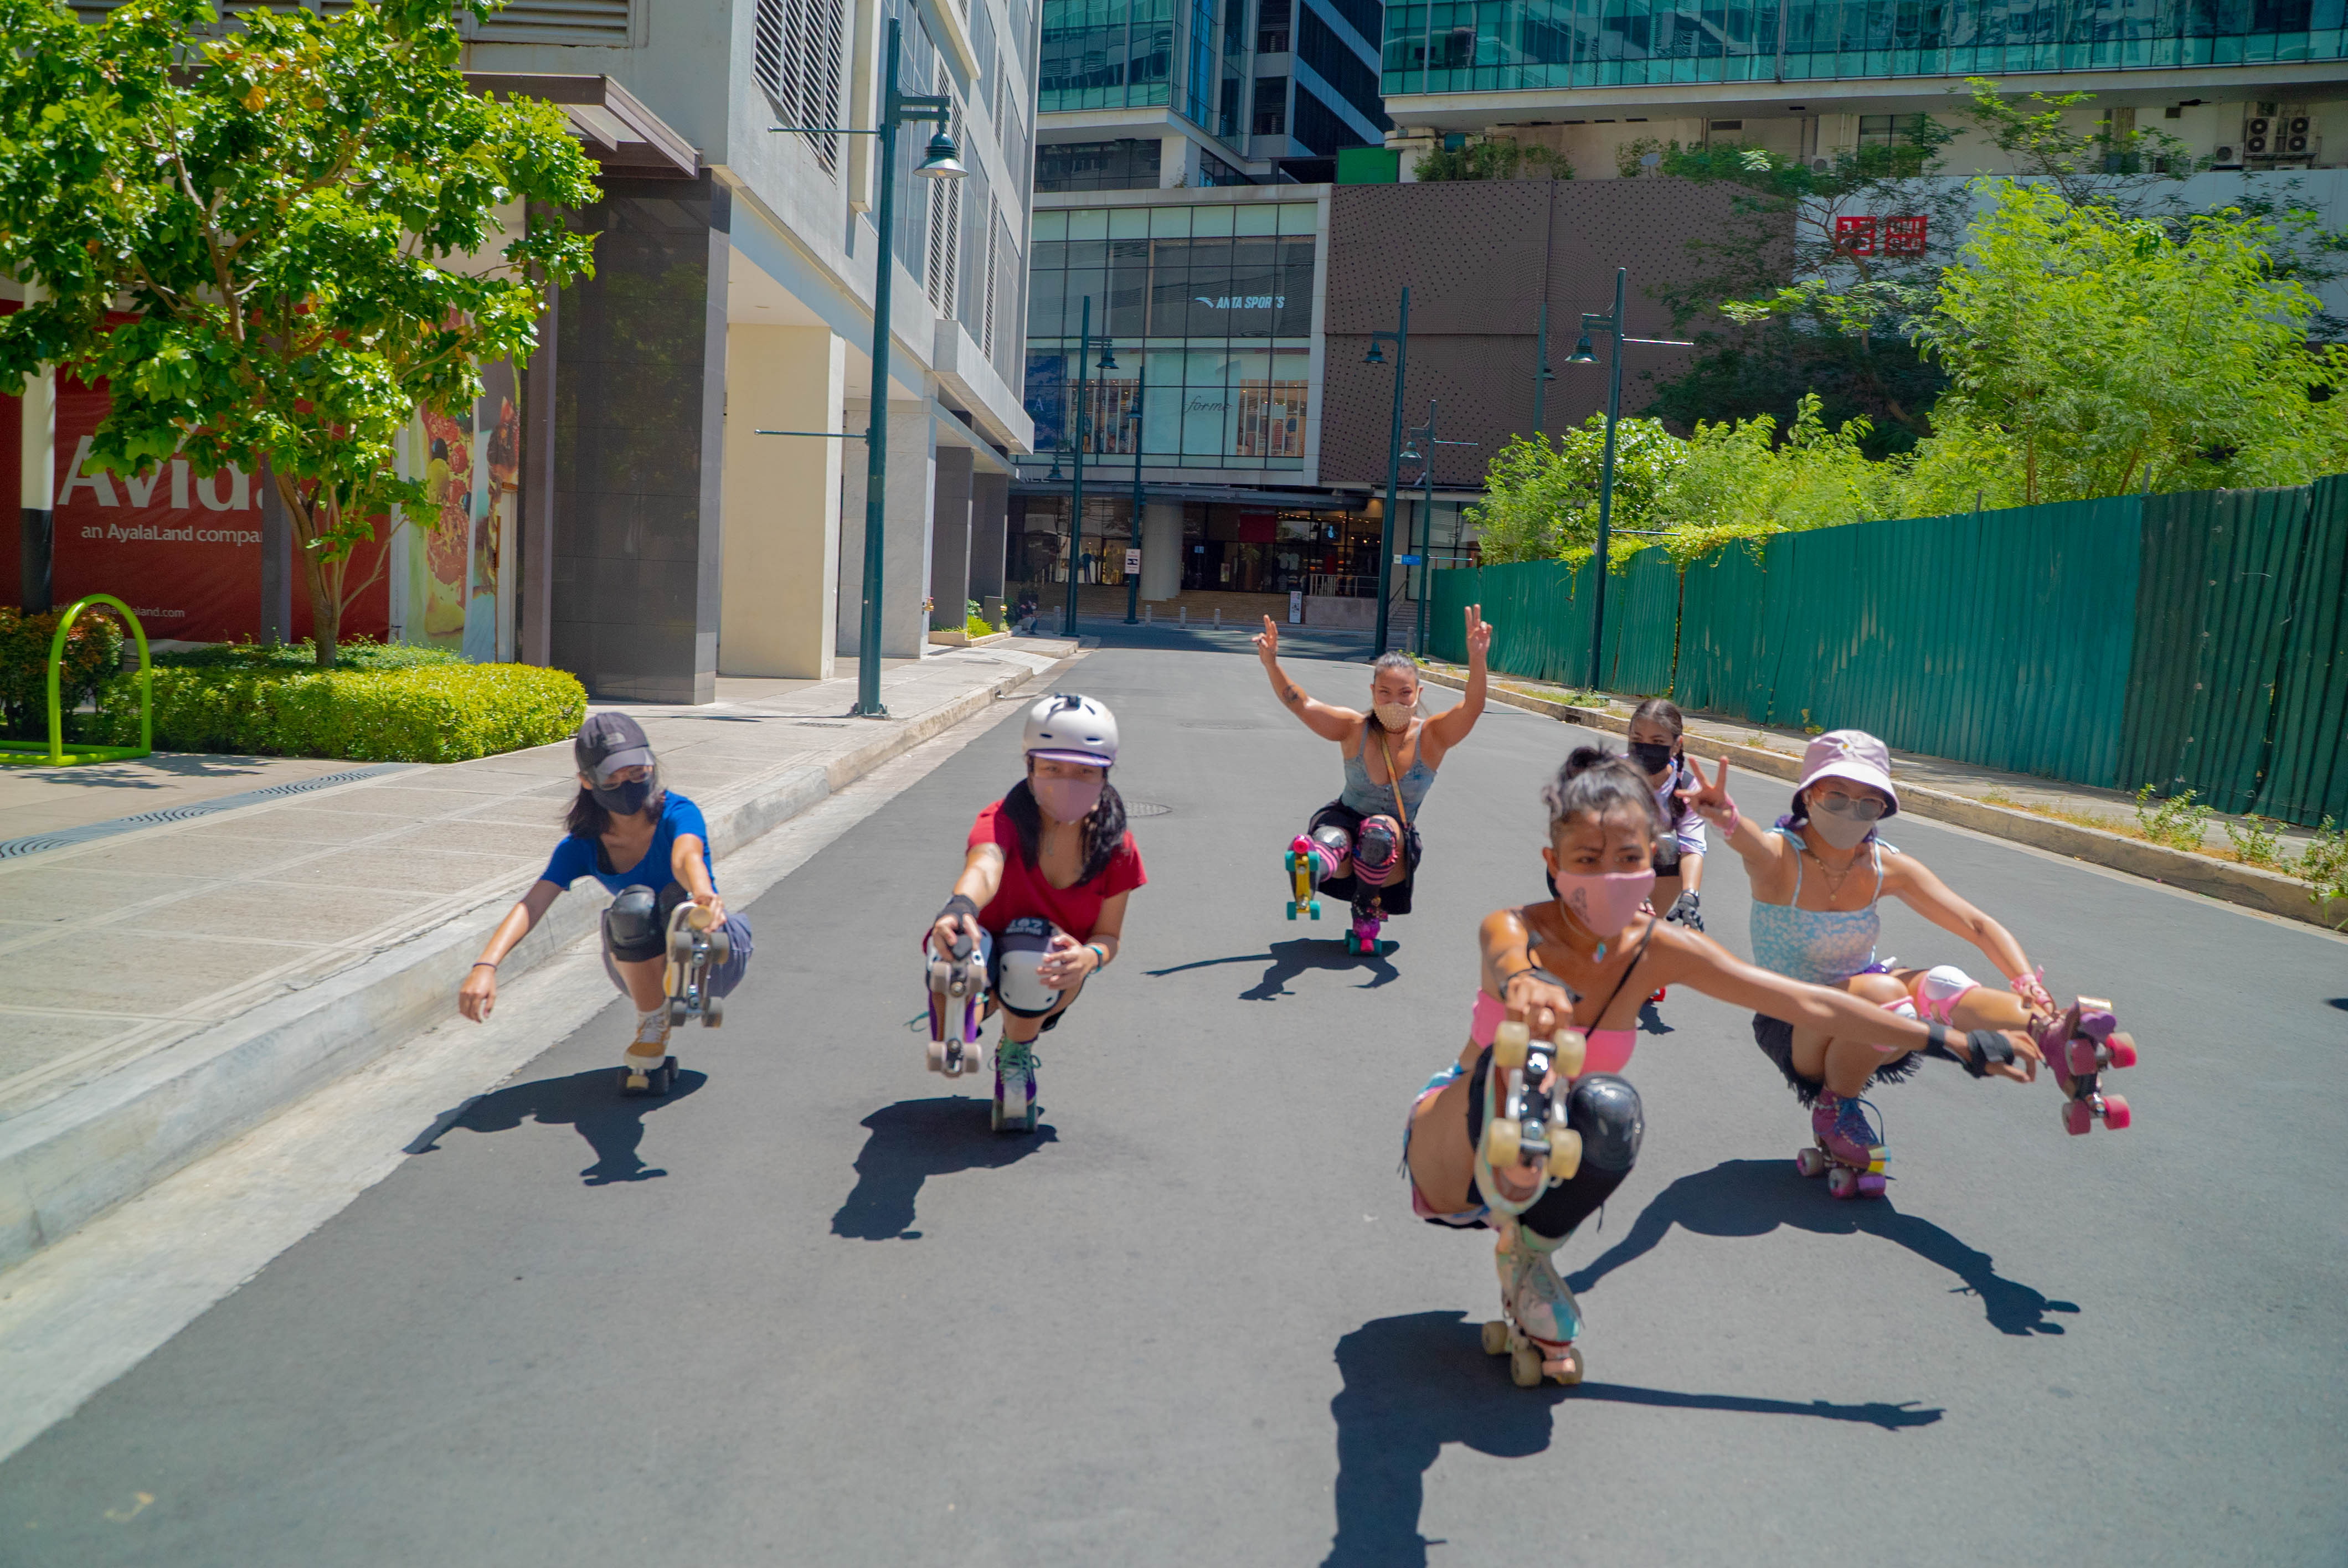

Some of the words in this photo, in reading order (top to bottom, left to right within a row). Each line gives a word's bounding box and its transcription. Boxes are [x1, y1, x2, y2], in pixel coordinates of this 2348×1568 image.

[1216, 297, 1242, 308] ANTA
[56, 423, 262, 511] Avid
[81, 527, 103, 539] an
[107, 524, 193, 543] AyalaLand
[196, 528, 263, 546] compa
